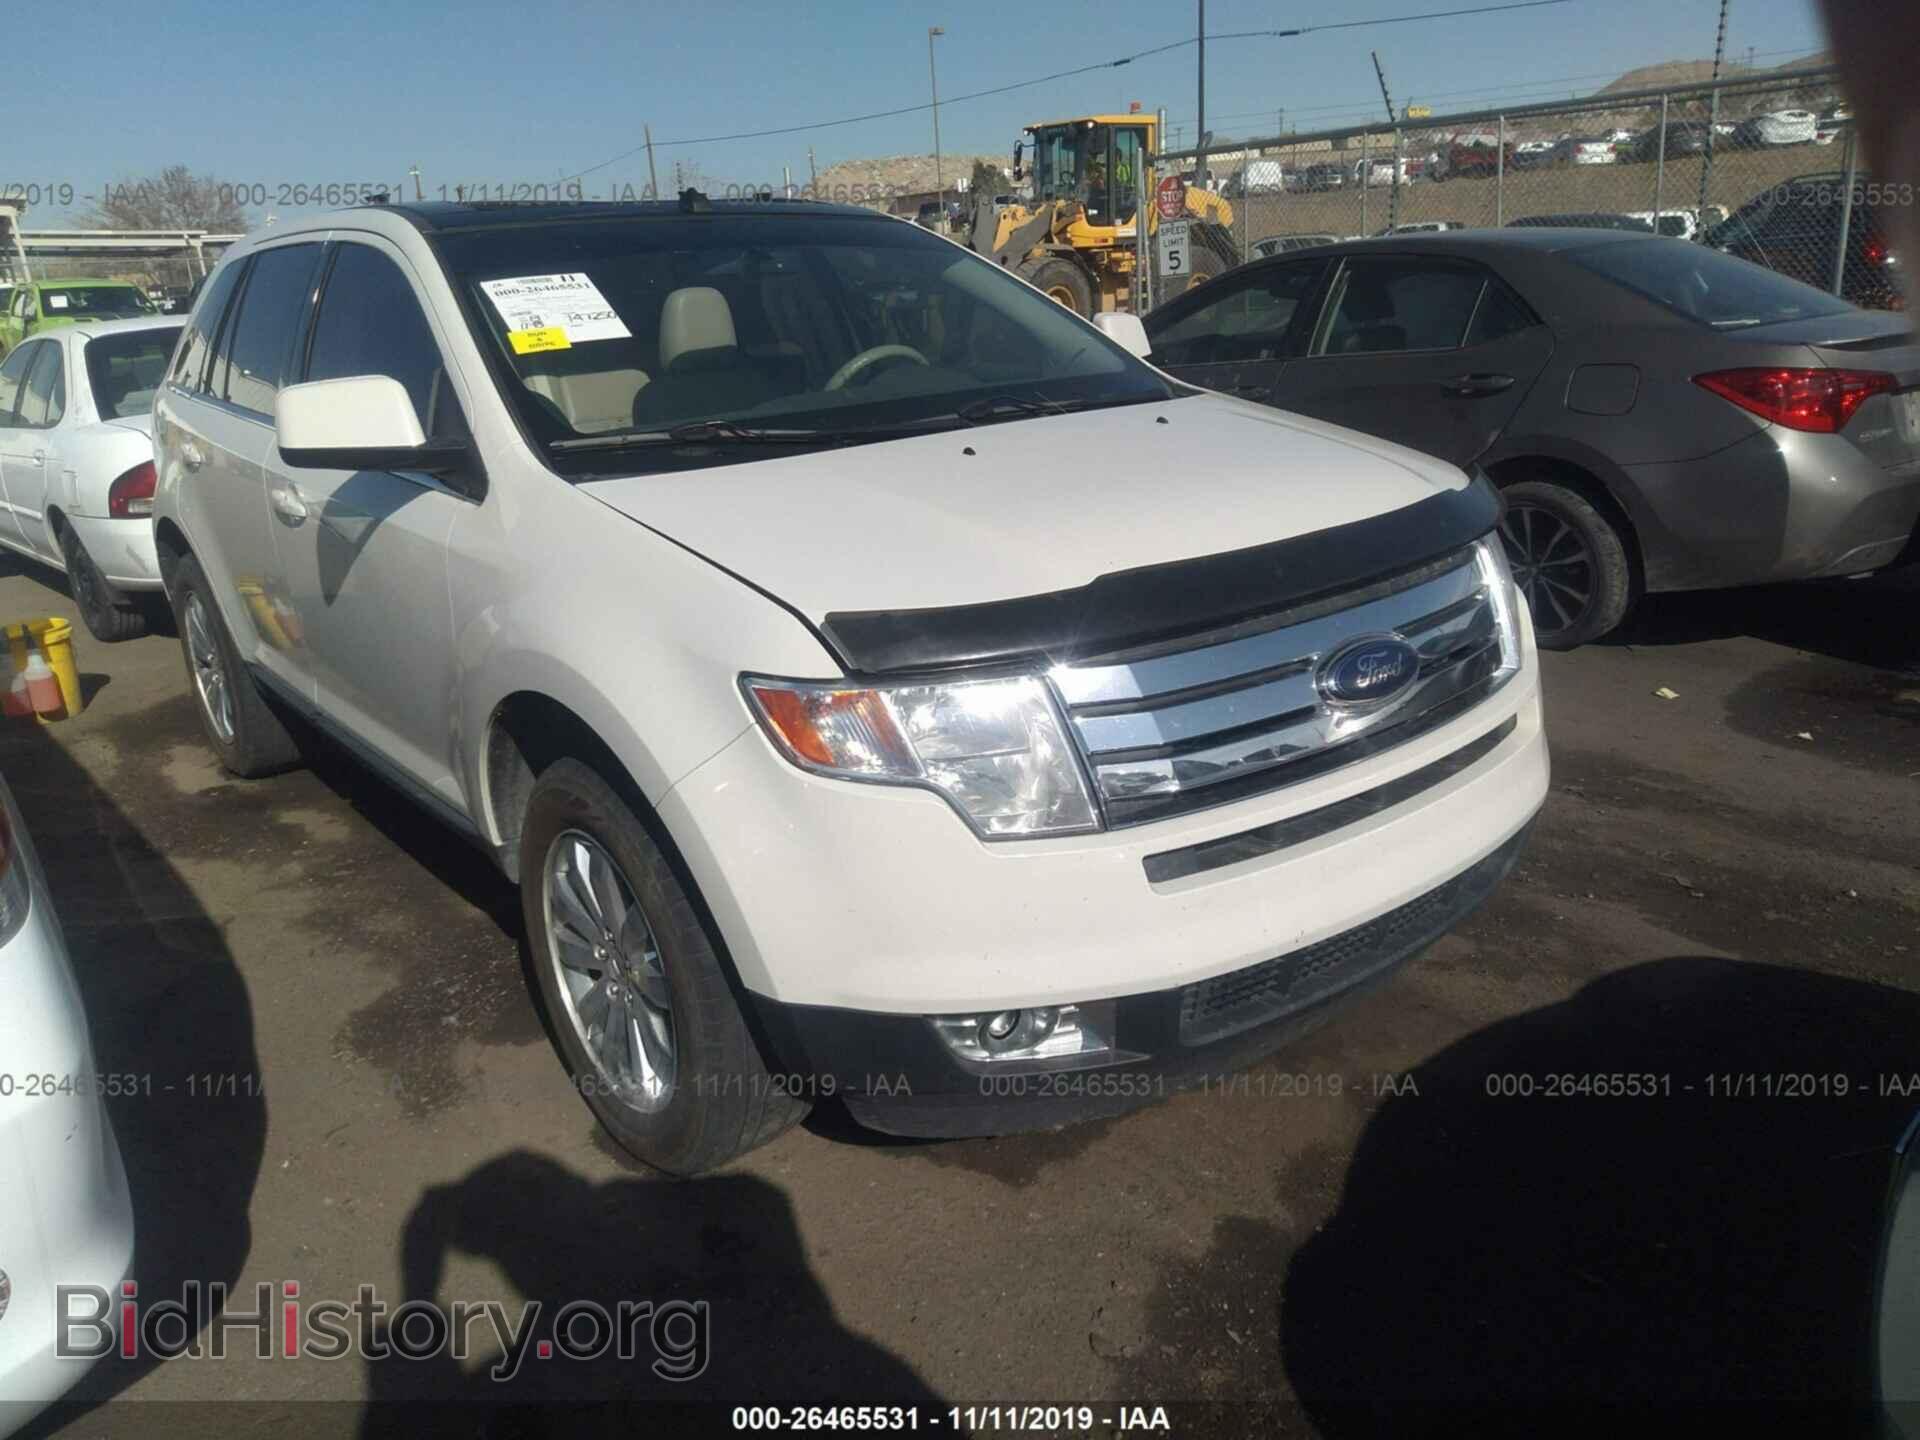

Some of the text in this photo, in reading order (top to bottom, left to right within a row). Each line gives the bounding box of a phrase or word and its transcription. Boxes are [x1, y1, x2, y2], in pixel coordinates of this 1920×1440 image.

[1161, 191, 1184, 203] STOP
[1160, 225, 1187, 236] SPEED
[1163, 238, 1185, 248] LIMIT
[1168, 250, 1181, 270] 5
[1355, 651, 1403, 687] Ford
